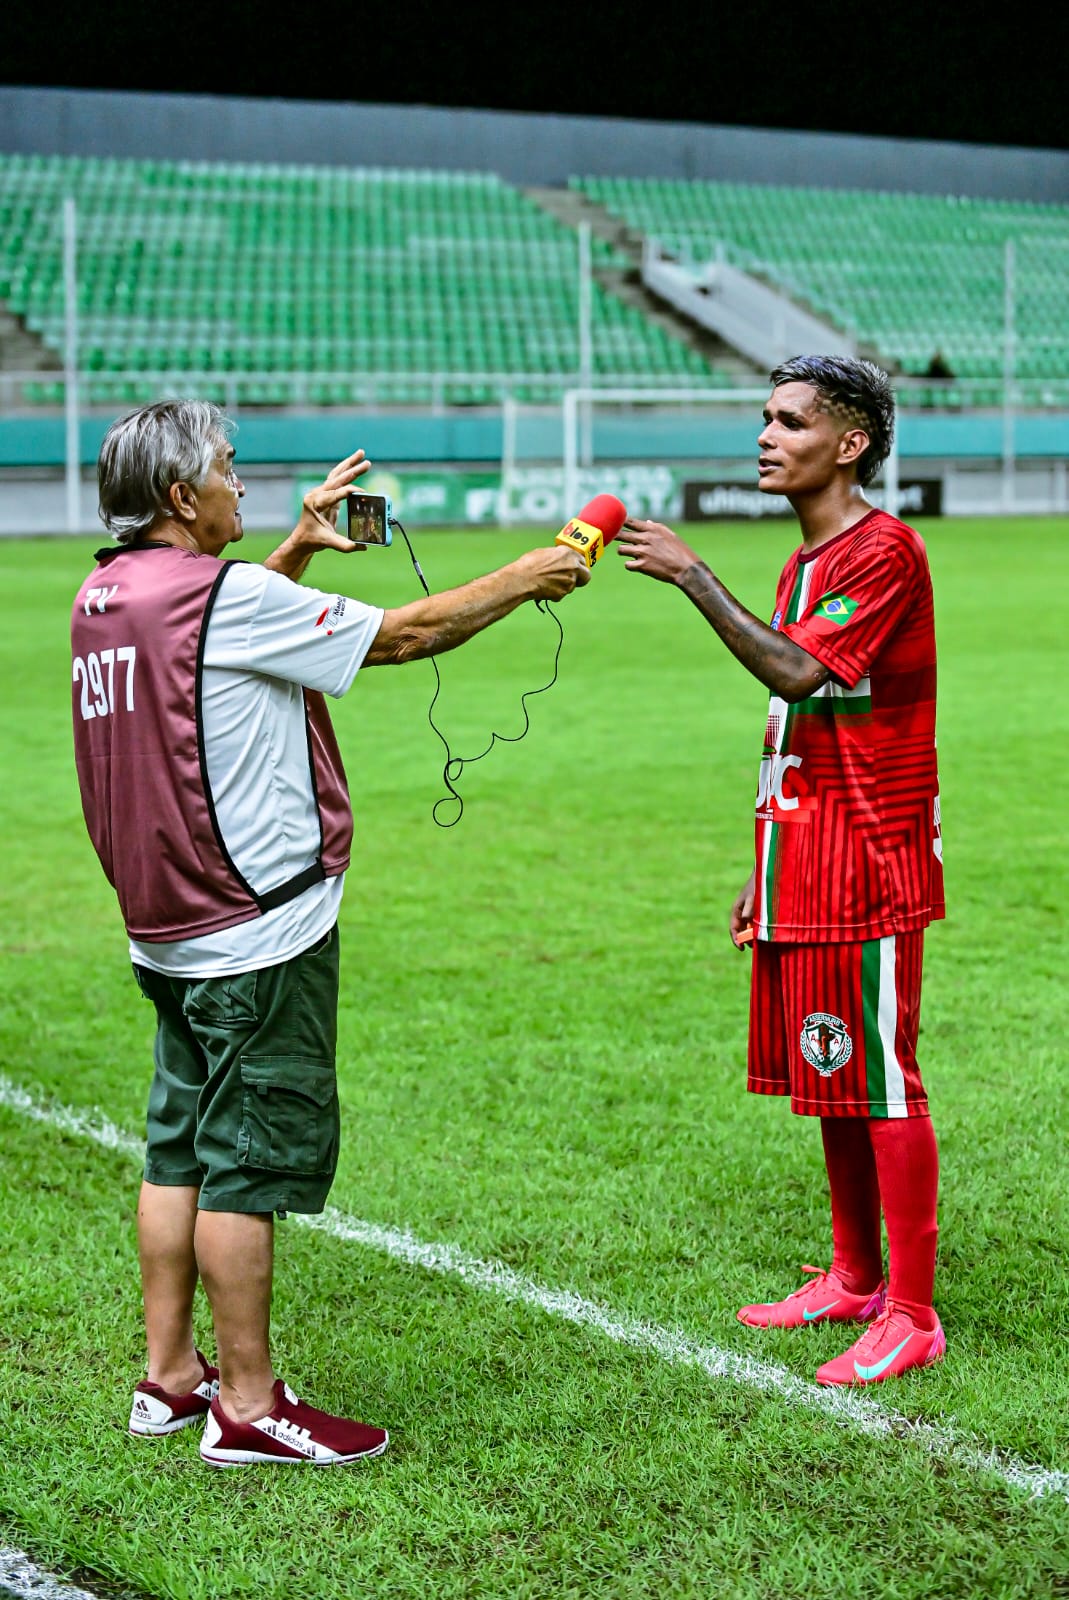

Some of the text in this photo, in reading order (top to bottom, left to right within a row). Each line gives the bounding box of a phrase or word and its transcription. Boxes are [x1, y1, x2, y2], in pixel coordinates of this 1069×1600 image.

[562, 521, 590, 546] blog
[72, 646, 136, 720] 2977
[277, 1431, 304, 1449] adidas
